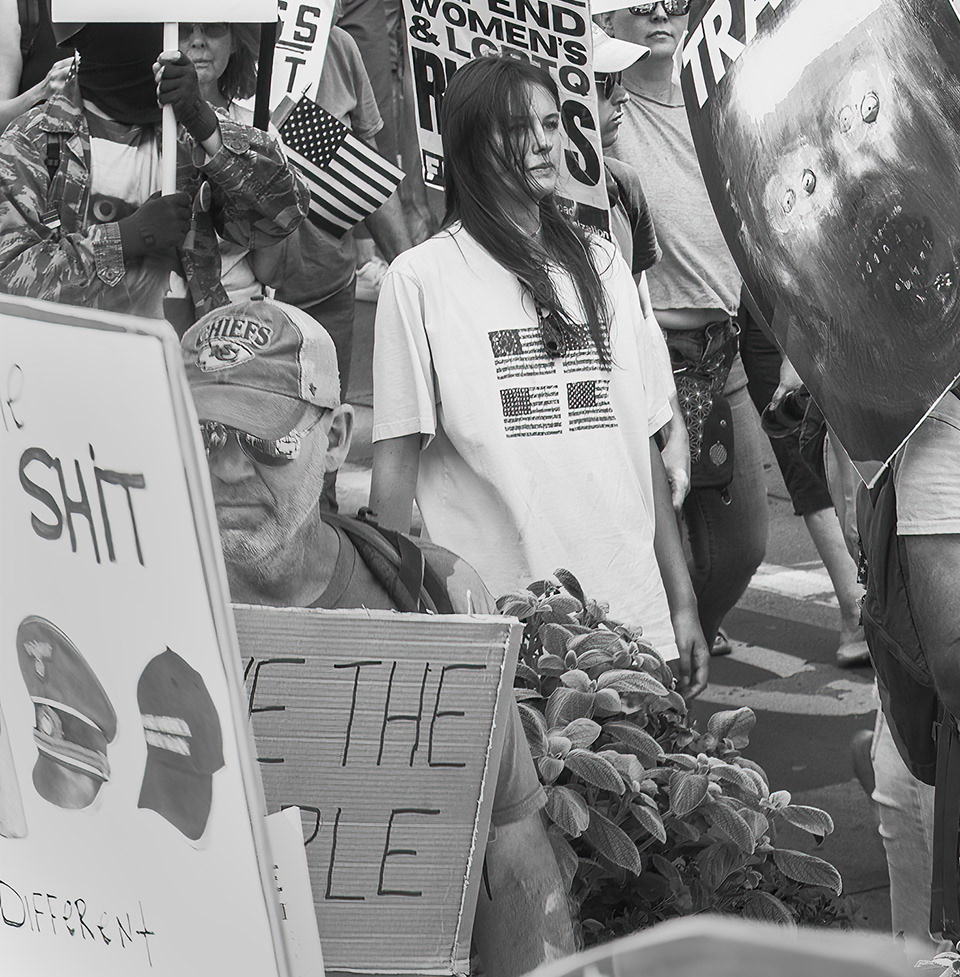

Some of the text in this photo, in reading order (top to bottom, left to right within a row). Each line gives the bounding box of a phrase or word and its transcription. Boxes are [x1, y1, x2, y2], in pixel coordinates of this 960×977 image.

[408, 14, 441, 48] &
[195, 316, 274, 349] CHIEFS
[333, 660, 488, 768] THE
